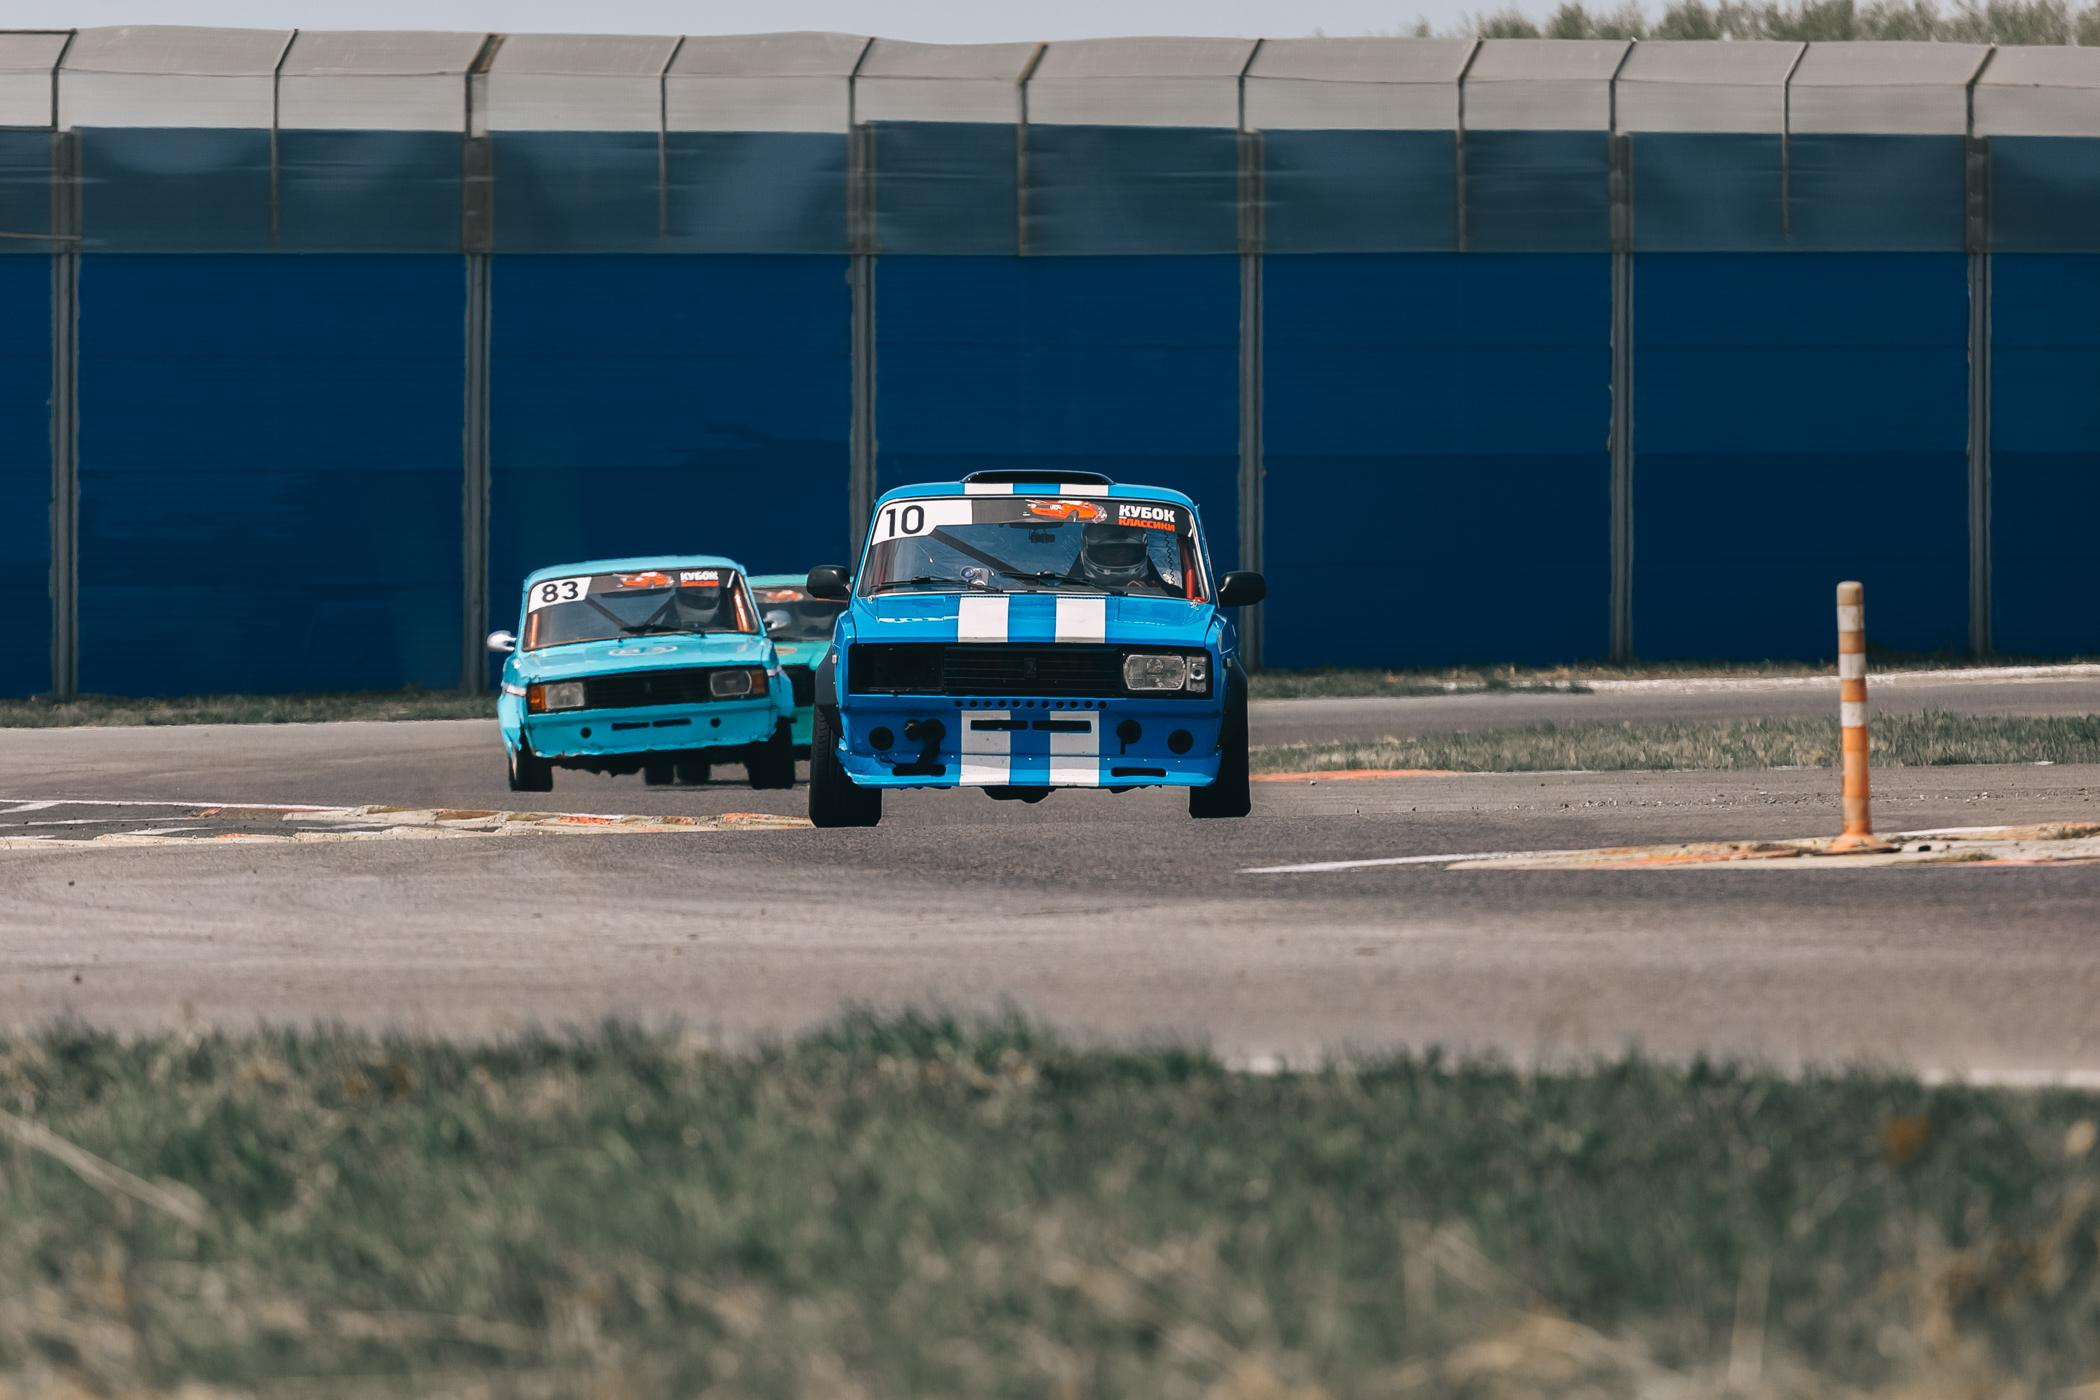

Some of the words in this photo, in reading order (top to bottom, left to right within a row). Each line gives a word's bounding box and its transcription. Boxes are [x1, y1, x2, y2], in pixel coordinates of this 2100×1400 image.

[886, 505, 924, 537] 10
[1119, 504, 1176, 523] КУБОК
[542, 581, 579, 603] 83
